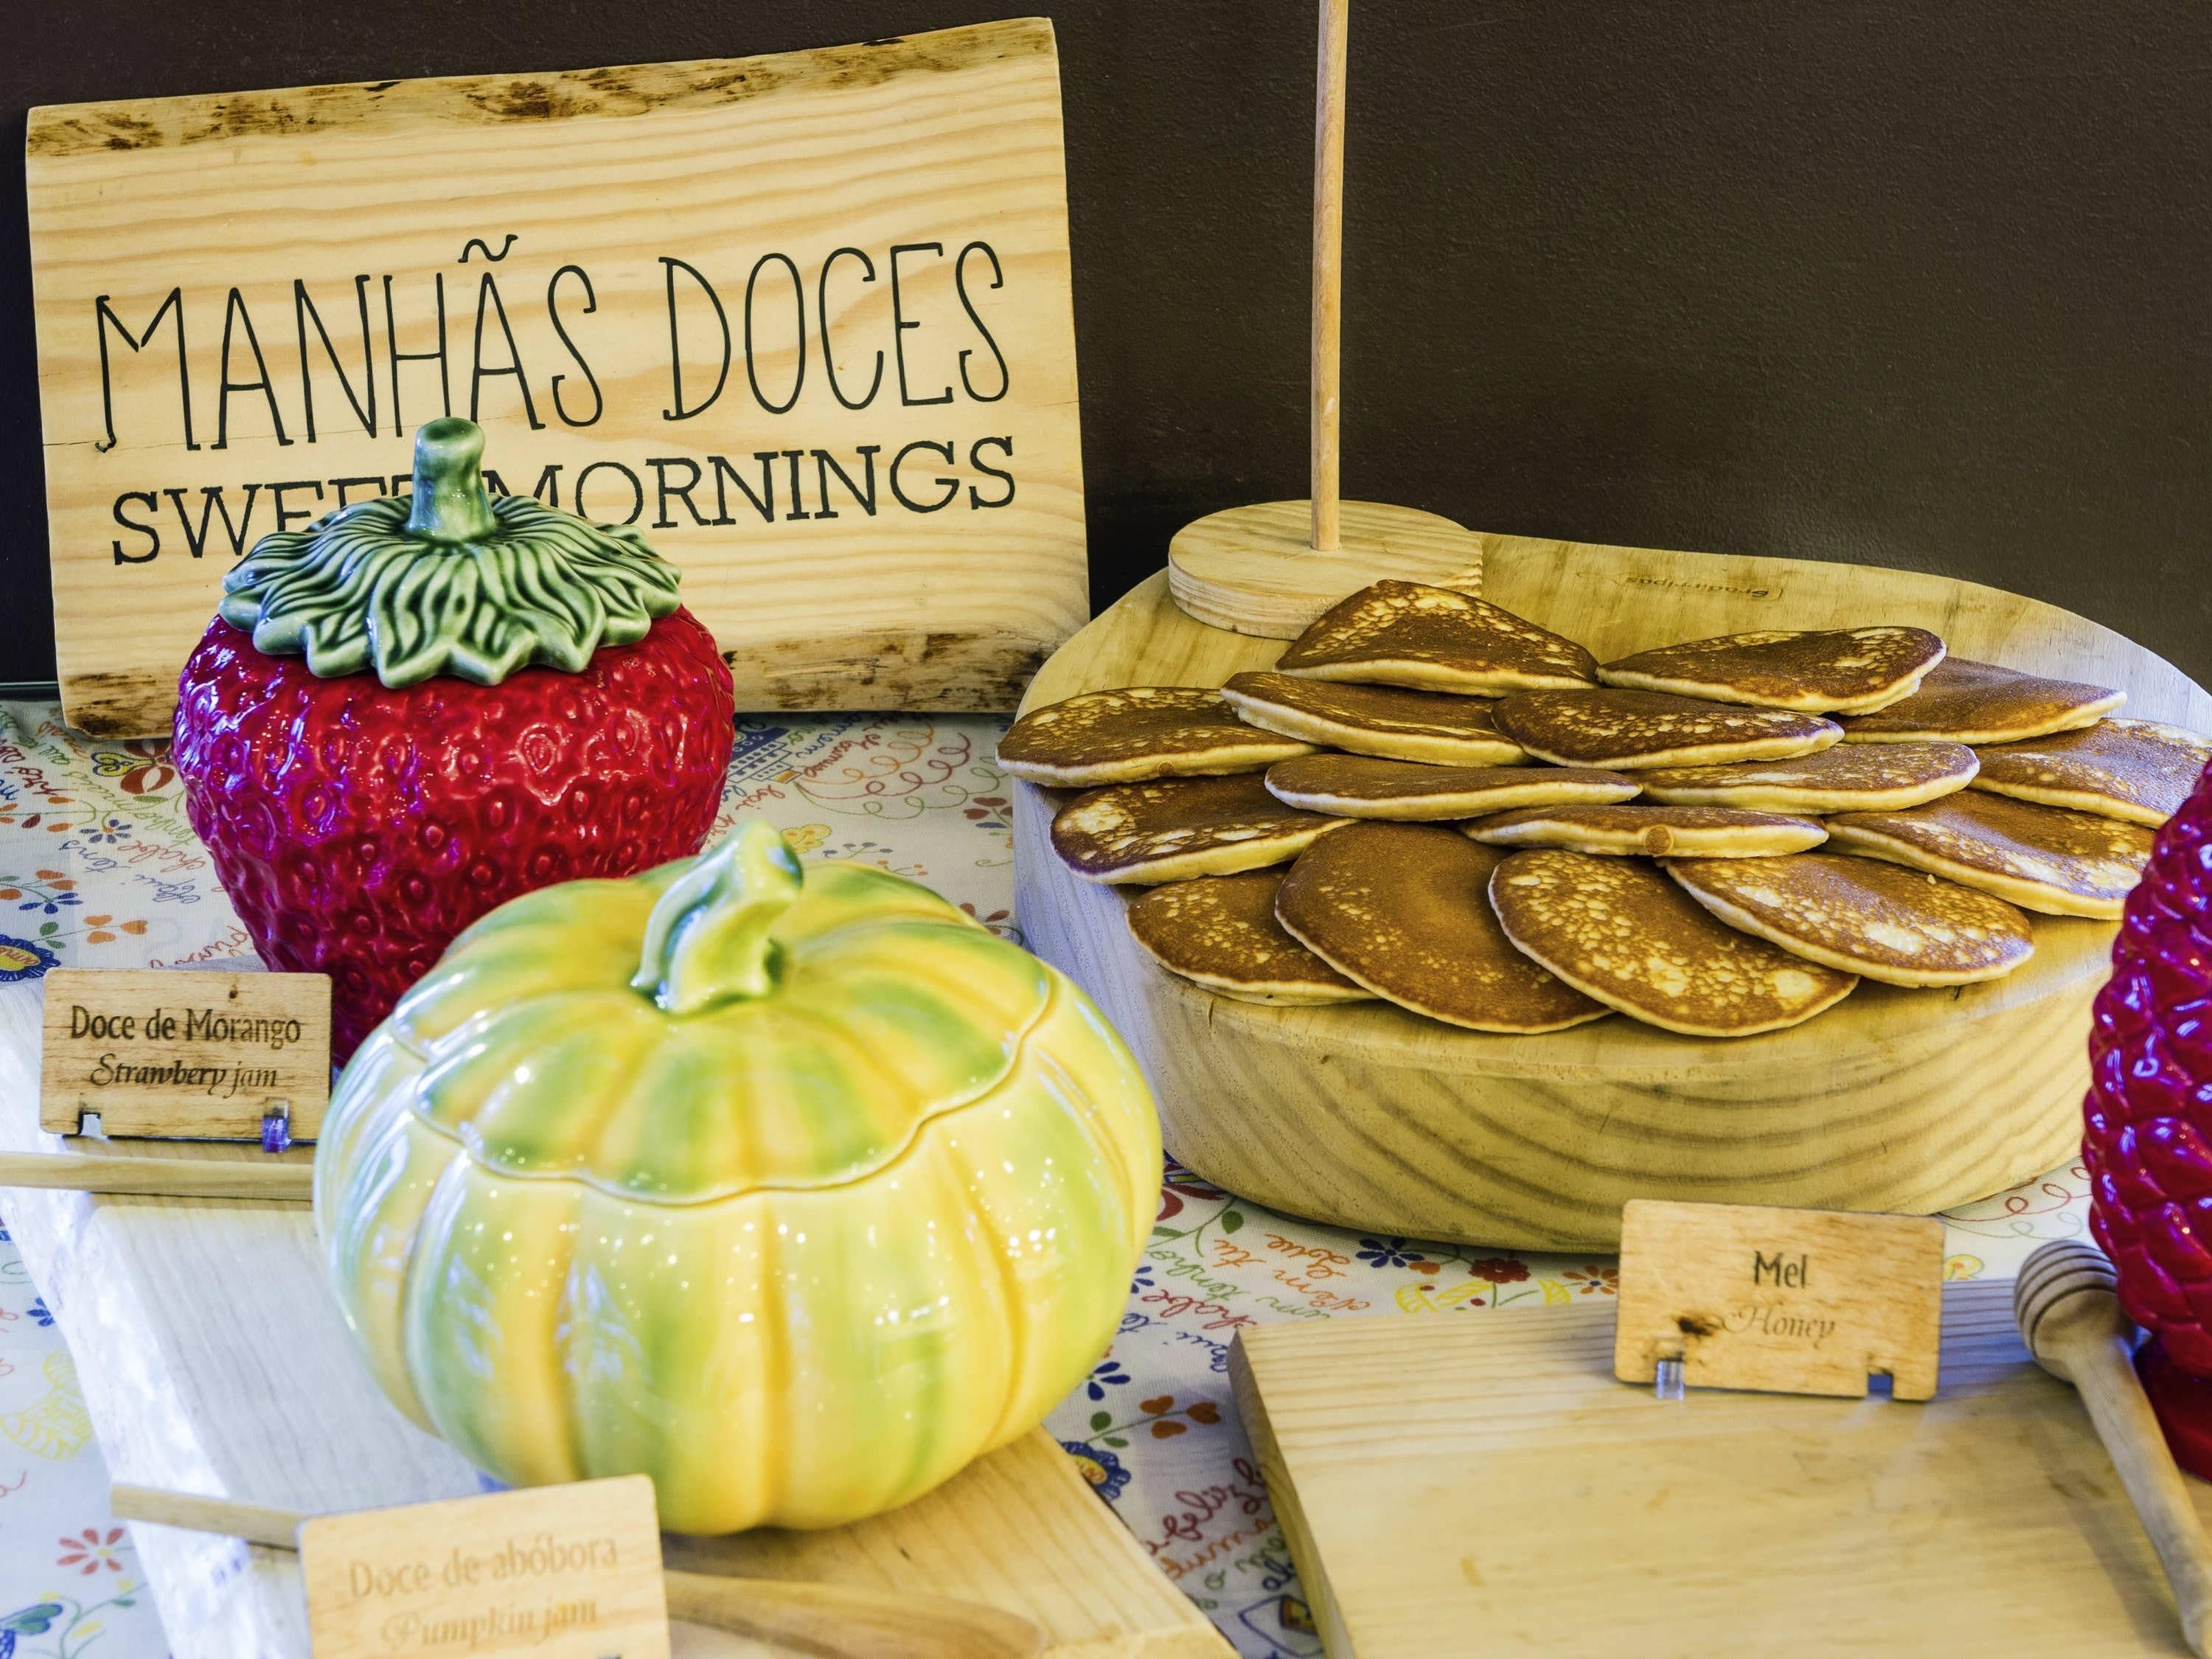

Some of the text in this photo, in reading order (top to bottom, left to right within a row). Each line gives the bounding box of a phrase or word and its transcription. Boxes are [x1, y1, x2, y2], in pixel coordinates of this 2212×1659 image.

[95, 234, 1009, 453] MANHÃS DOCES
[112, 476, 413, 566] SWE
[71, 1004, 302, 1051] Doce de Morango
[222, 1060, 278, 1099] jam
[1753, 1250, 1809, 1289] Mel
[1720, 1303, 1836, 1351] Honey
[349, 1533, 617, 1599] Doce de abóbora
[380, 1595, 597, 1651] Pumpkin jam
